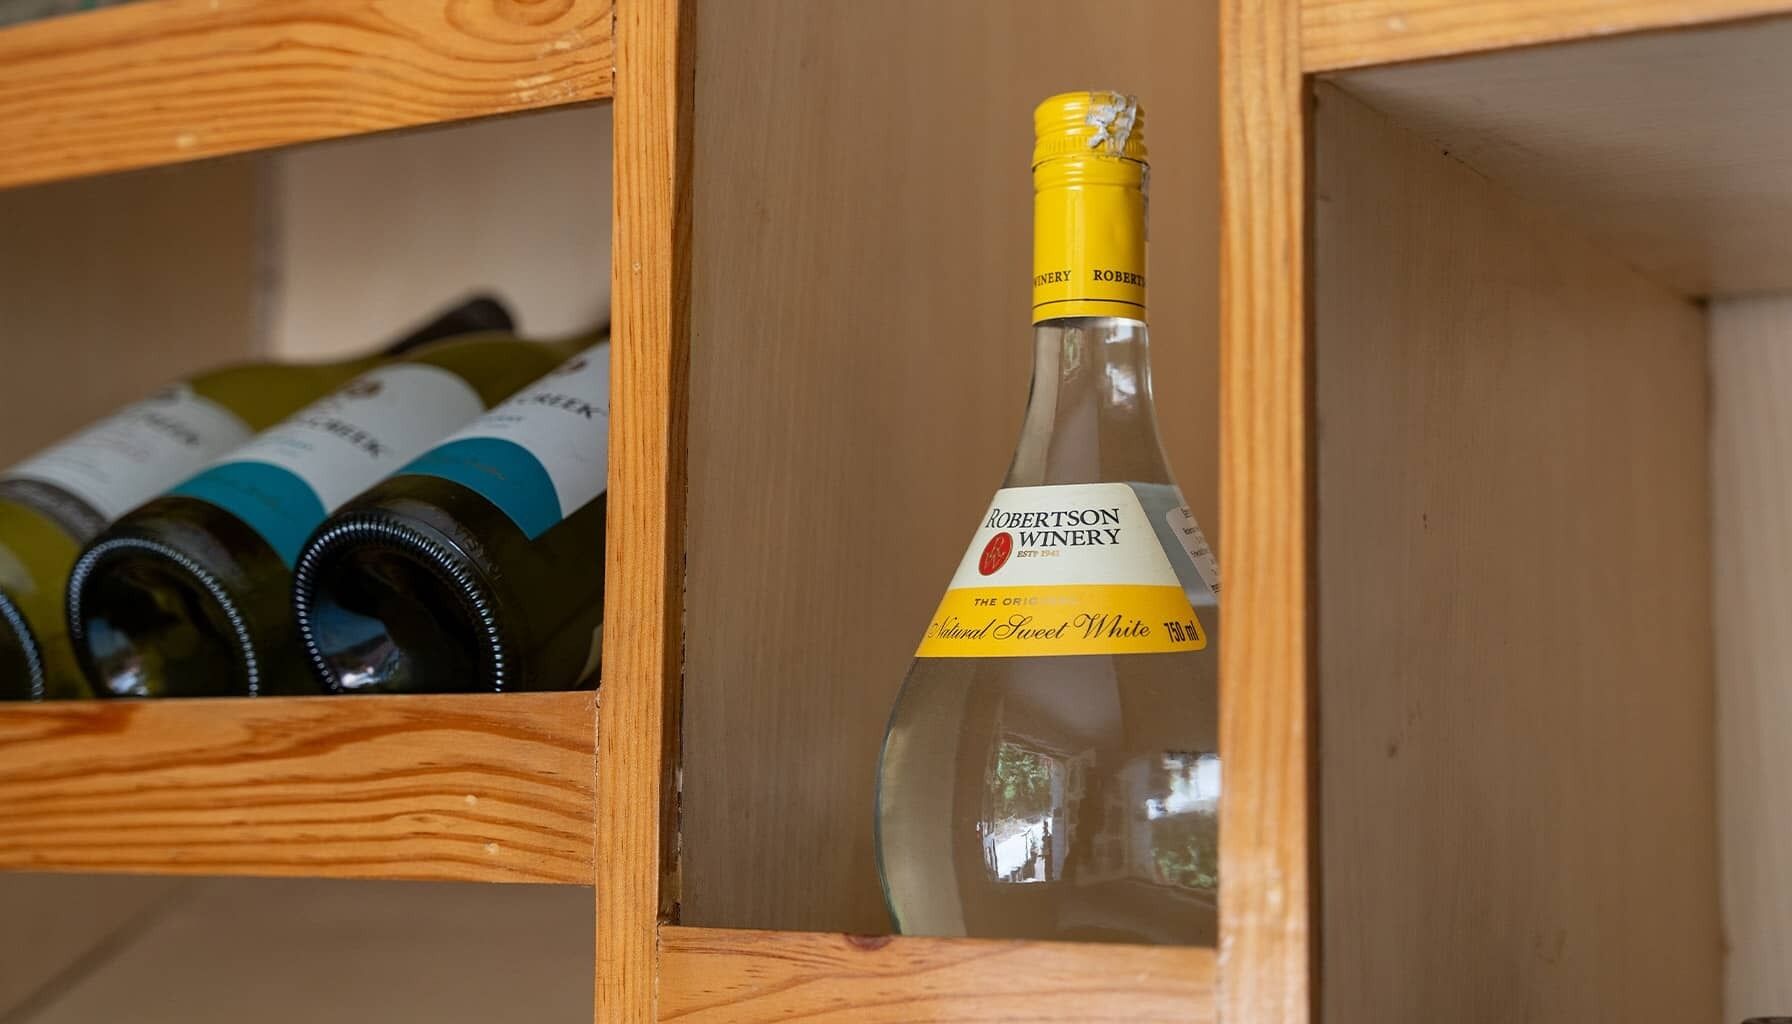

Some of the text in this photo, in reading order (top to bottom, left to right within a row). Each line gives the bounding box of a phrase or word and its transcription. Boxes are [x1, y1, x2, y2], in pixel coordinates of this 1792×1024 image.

[985, 508, 1121, 529] ROBERTSON
[1018, 528, 1121, 548] WINERY
[974, 598, 997, 607] THE
[928, 613, 1151, 641] Natural Sweet White
[1164, 620, 1200, 643] 750 ml
